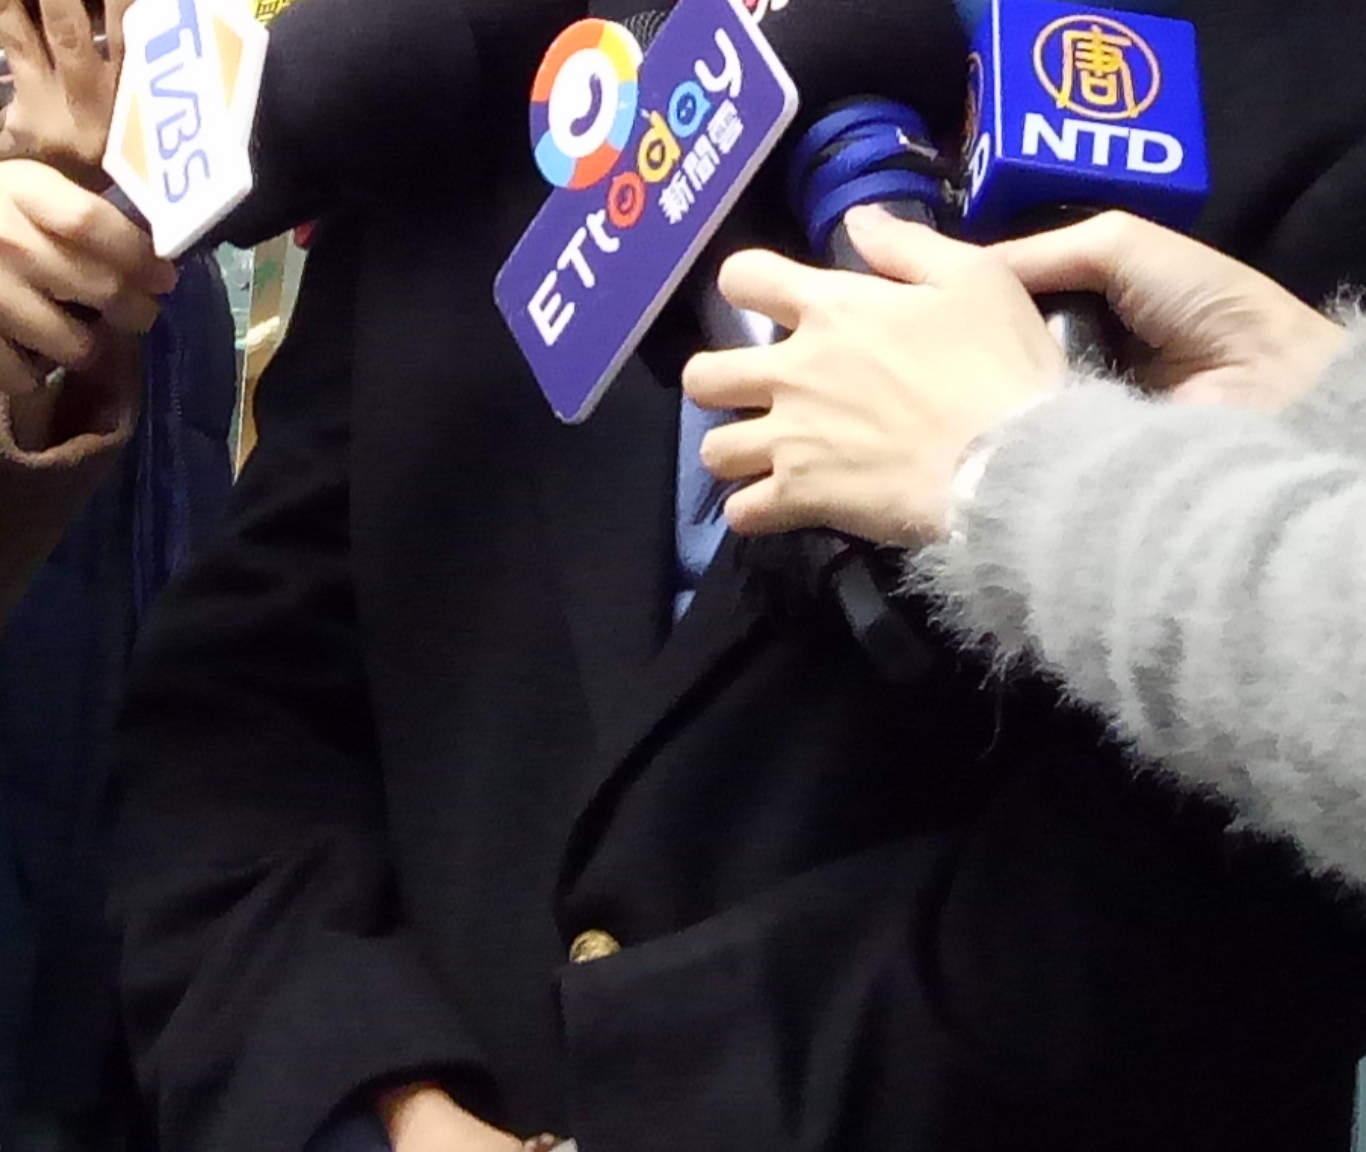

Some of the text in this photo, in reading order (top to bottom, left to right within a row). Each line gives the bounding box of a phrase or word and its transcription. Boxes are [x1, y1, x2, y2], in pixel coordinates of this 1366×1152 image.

[1053, 22, 1141, 118] 唐
[528, 28, 742, 346] ETtoday
[659, 100, 744, 224] 新聞雲
[1021, 112, 1184, 174] NTD
